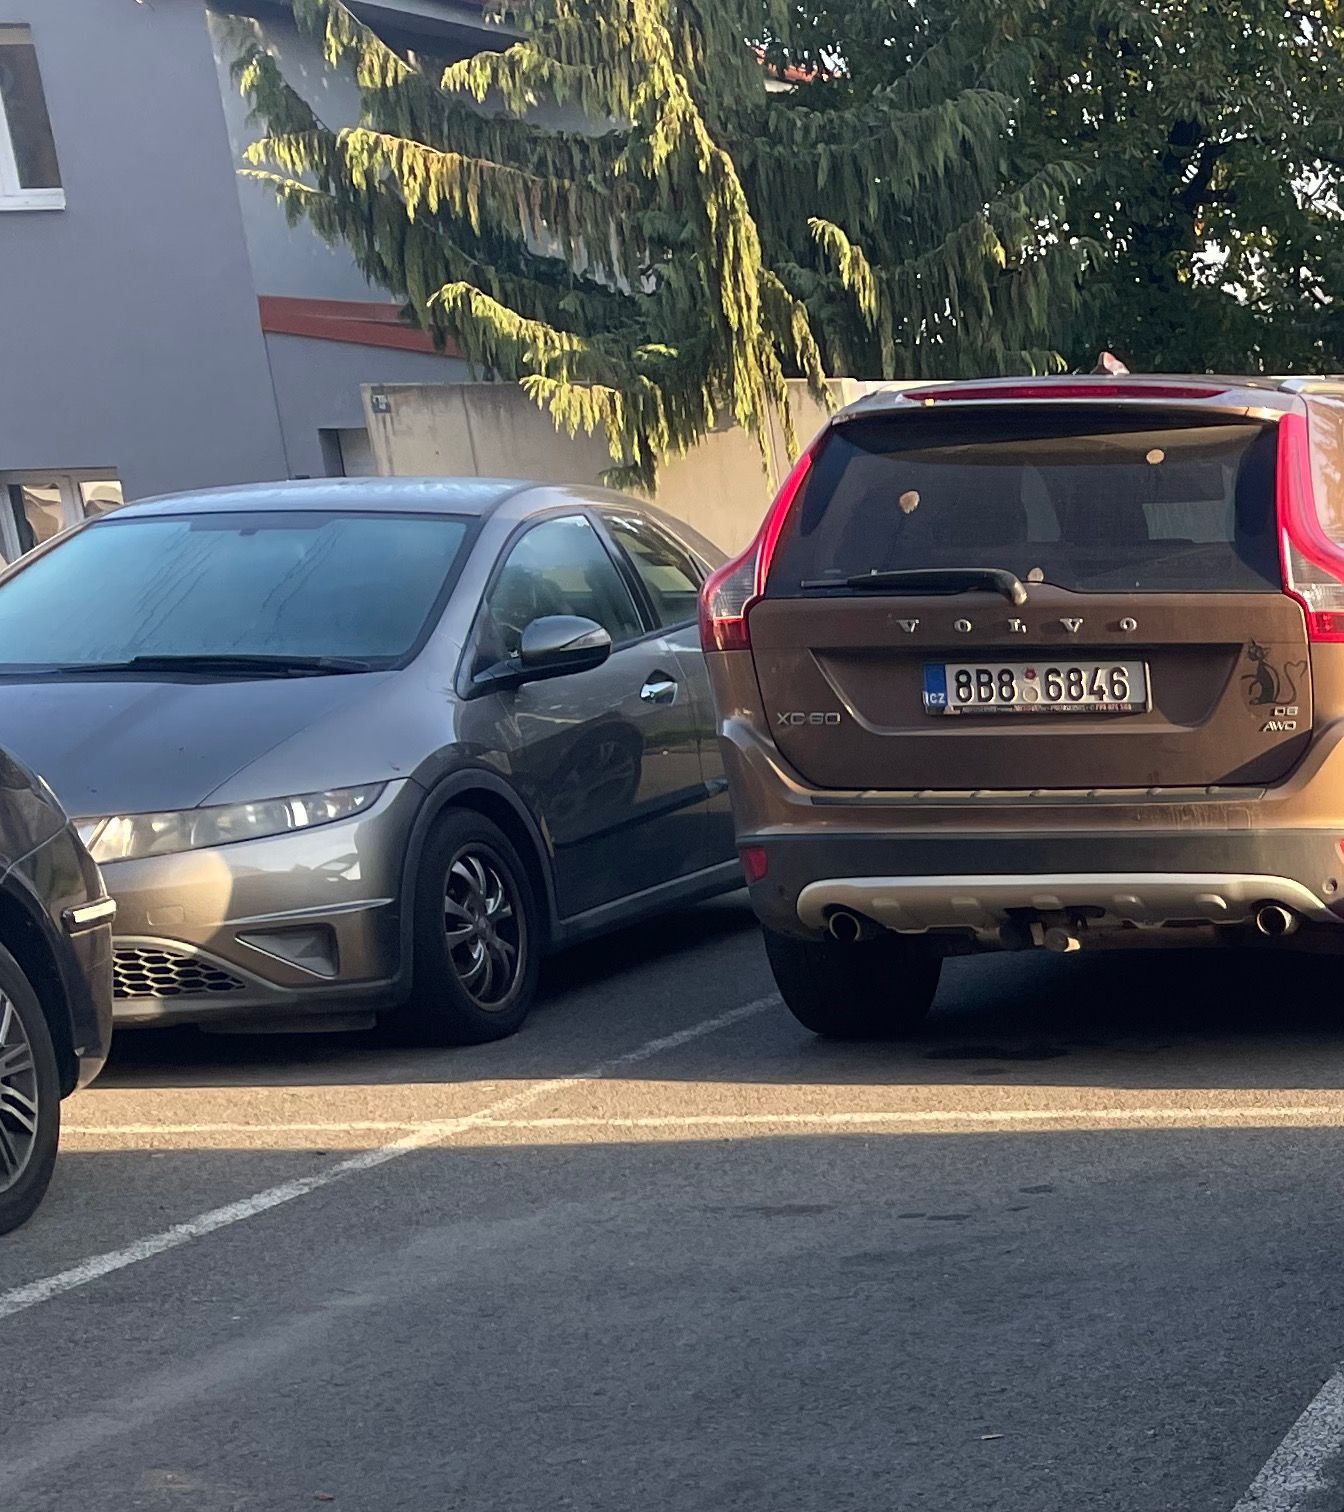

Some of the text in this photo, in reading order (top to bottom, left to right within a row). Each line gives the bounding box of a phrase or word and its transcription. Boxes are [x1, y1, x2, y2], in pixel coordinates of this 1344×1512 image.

[896, 617, 1138, 633] VOLVO
[930, 666, 1129, 704] CZ 8B8 6846
[1262, 720, 1297, 732] AWD
